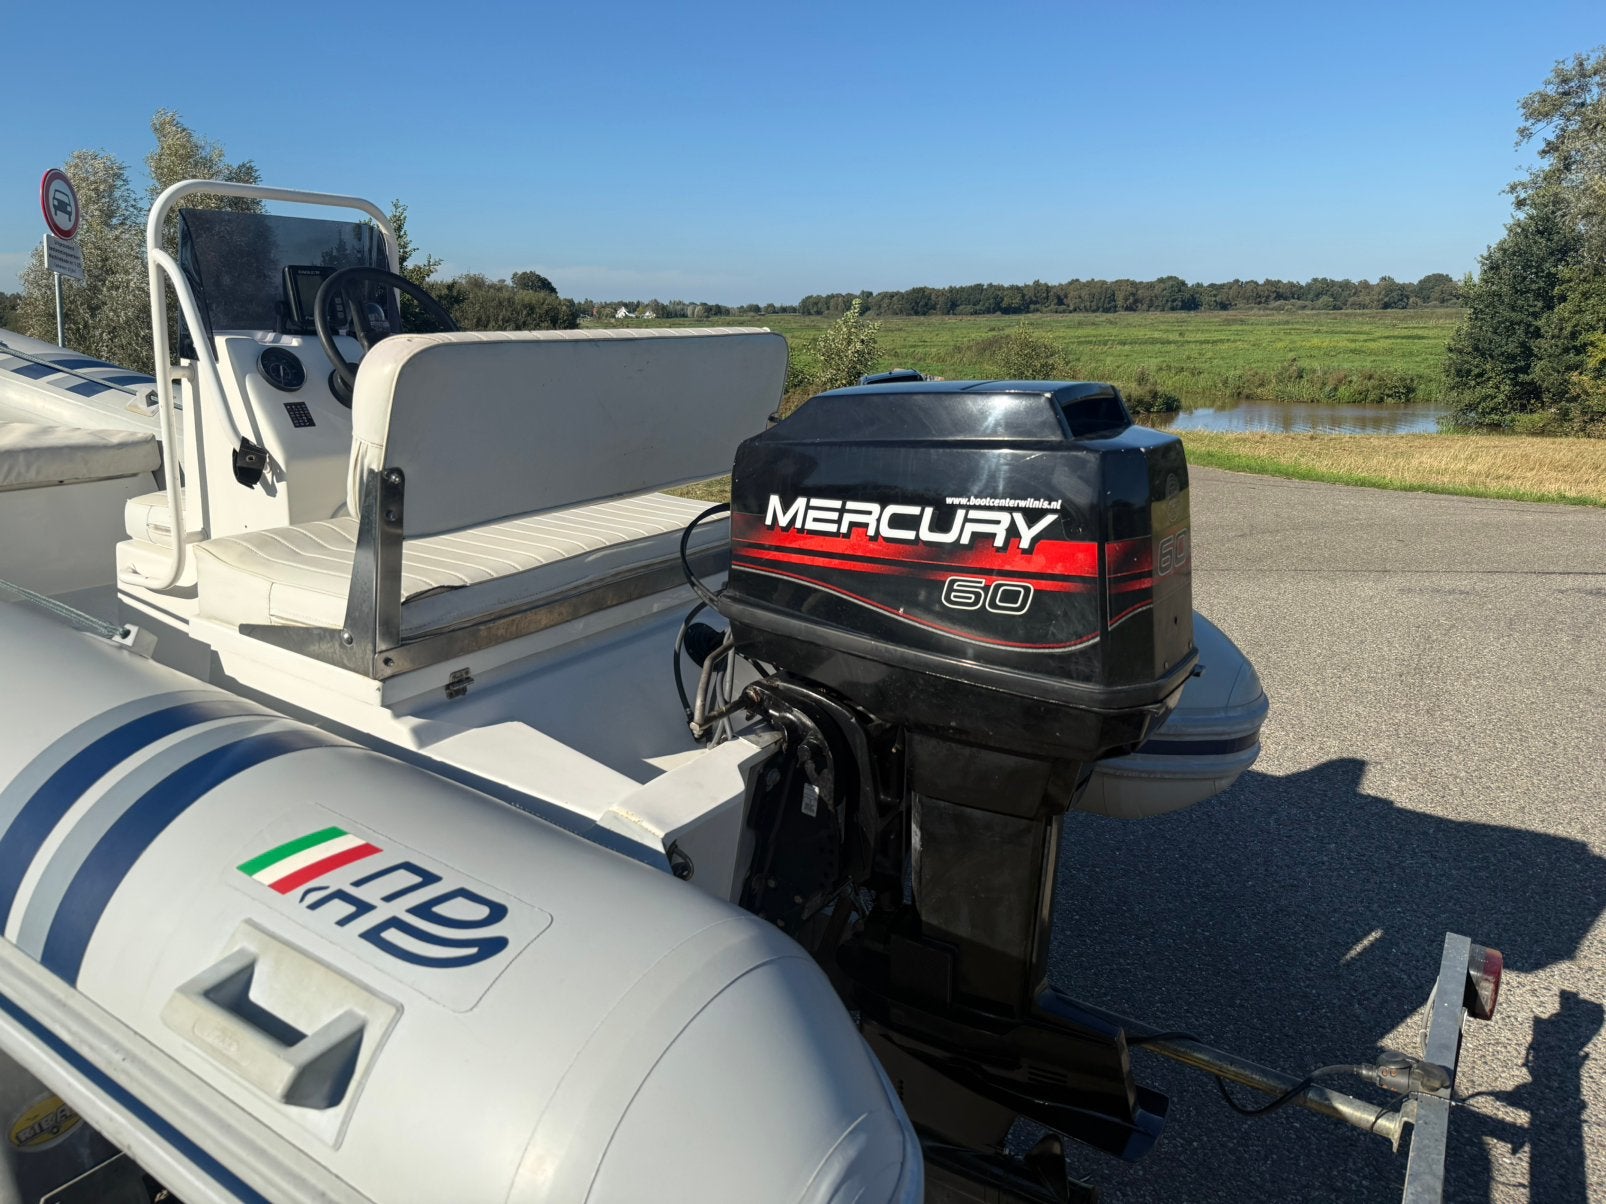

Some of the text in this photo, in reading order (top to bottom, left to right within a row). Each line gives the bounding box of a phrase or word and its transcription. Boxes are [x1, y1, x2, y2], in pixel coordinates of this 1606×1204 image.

[765, 494, 1058, 549] MERCURY
[945, 496, 1062, 510] www.bootcenterwilnis.nl
[1158, 528, 1188, 576] 60
[941, 576, 1034, 615] 60
